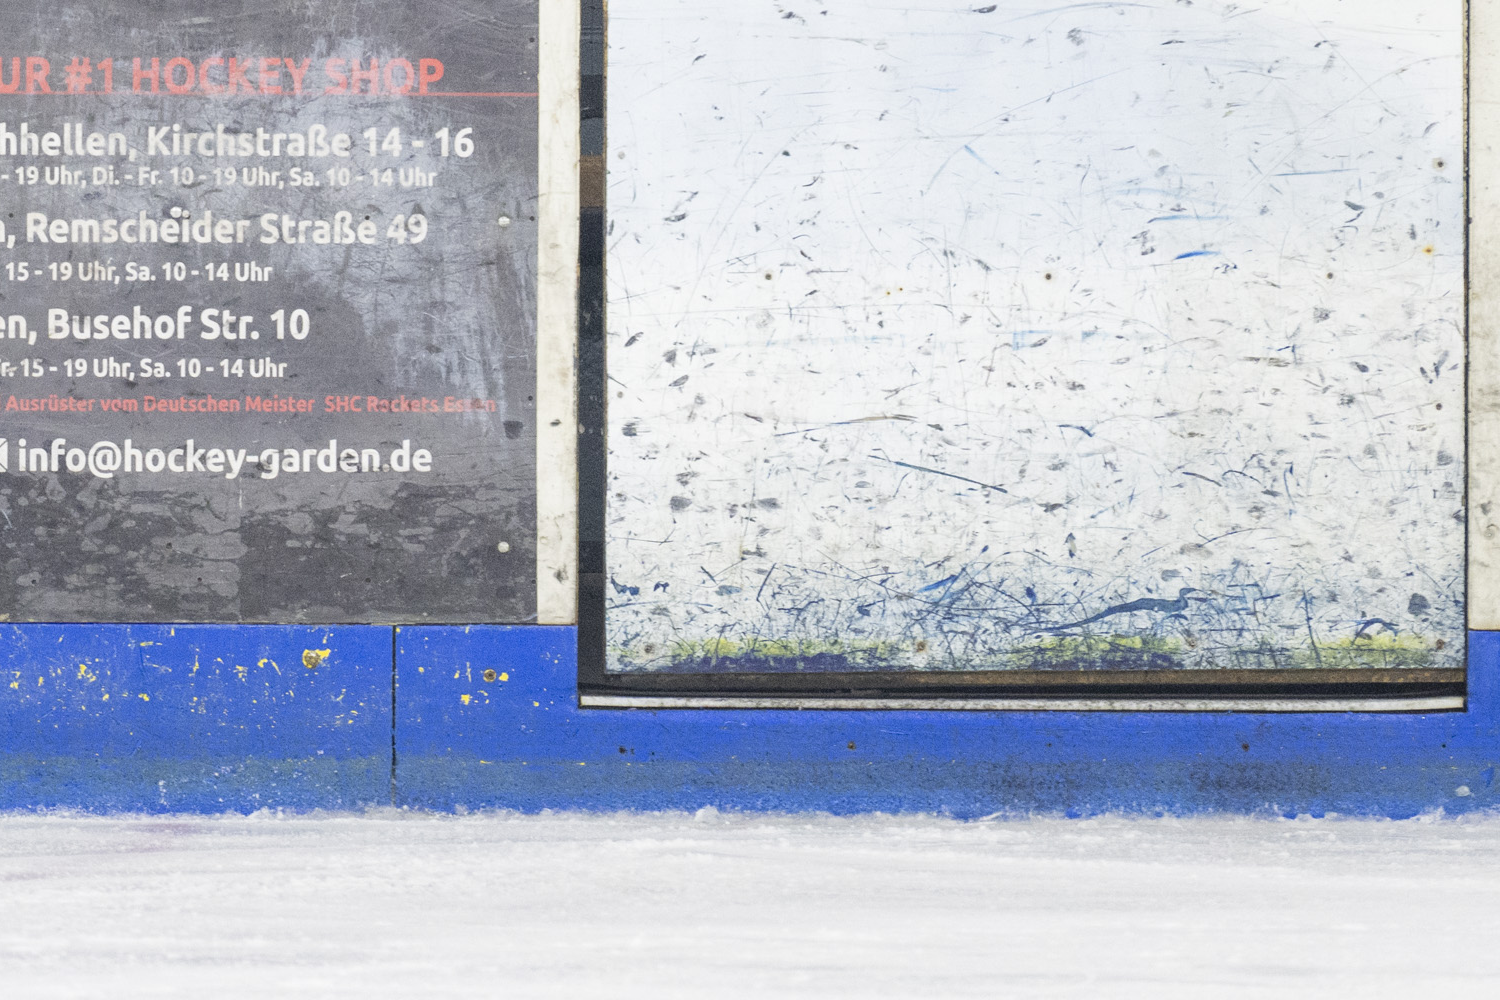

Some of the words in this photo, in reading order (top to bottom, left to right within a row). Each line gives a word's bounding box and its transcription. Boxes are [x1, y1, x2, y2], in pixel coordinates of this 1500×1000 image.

[65, 57, 113, 93] #1
[132, 57, 311, 95] HOCKEY
[325, 58, 444, 95] SHOP
[148, 123, 350, 157] Kirchstraße
[363, 127, 402, 157] 14
[435, 127, 475, 158] 16
[15, 166, 39, 185] 19
[45, 165, 87, 188] Uhr,
[92, 166, 119, 185] Di.
[139, 167, 162, 185] Fr.
[170, 167, 194, 185] 10
[213, 168, 237, 186] 19
[242, 167, 284, 189] Uhr,
[290, 168, 320, 187] Sa.
[327, 168, 349, 187] 10
[369, 168, 393, 187] 14
[399, 166, 437, 187] Uhr
[26, 208, 250, 244] Remscheider
[260, 211, 377, 245] Straße
[386, 213, 428, 245] 49
[5, 262, 30, 281] 15
[49, 262, 73, 281] 19
[78, 260, 120, 285] Uhr,
[125, 262, 156, 281] Sa.
[162, 262, 187, 281] 10
[204, 263, 229, 281] 14
[235, 261, 273, 282] Uhr
[48, 305, 192, 340] Busehof
[200, 308, 260, 340] Str.
[270, 309, 311, 340] 10
[20, 358, 45, 377] 15
[63, 358, 88, 378] 19
[93, 357, 135, 381] Uhr,
[140, 358, 171, 378] Sa.
[177, 358, 201, 378] 10
[219, 358, 244, 378] 14
[249, 357, 288, 378] Uhr
[5, 394, 96, 412] Ausrüster
[100, 399, 138, 412] vom
[143, 395, 240, 412] Deutschen
[245, 395, 314, 412] Meister
[324, 395, 362, 413] SHC
[366, 395, 438, 413] Rockets
[17, 437, 433, 480] info@hockey-garden.de
